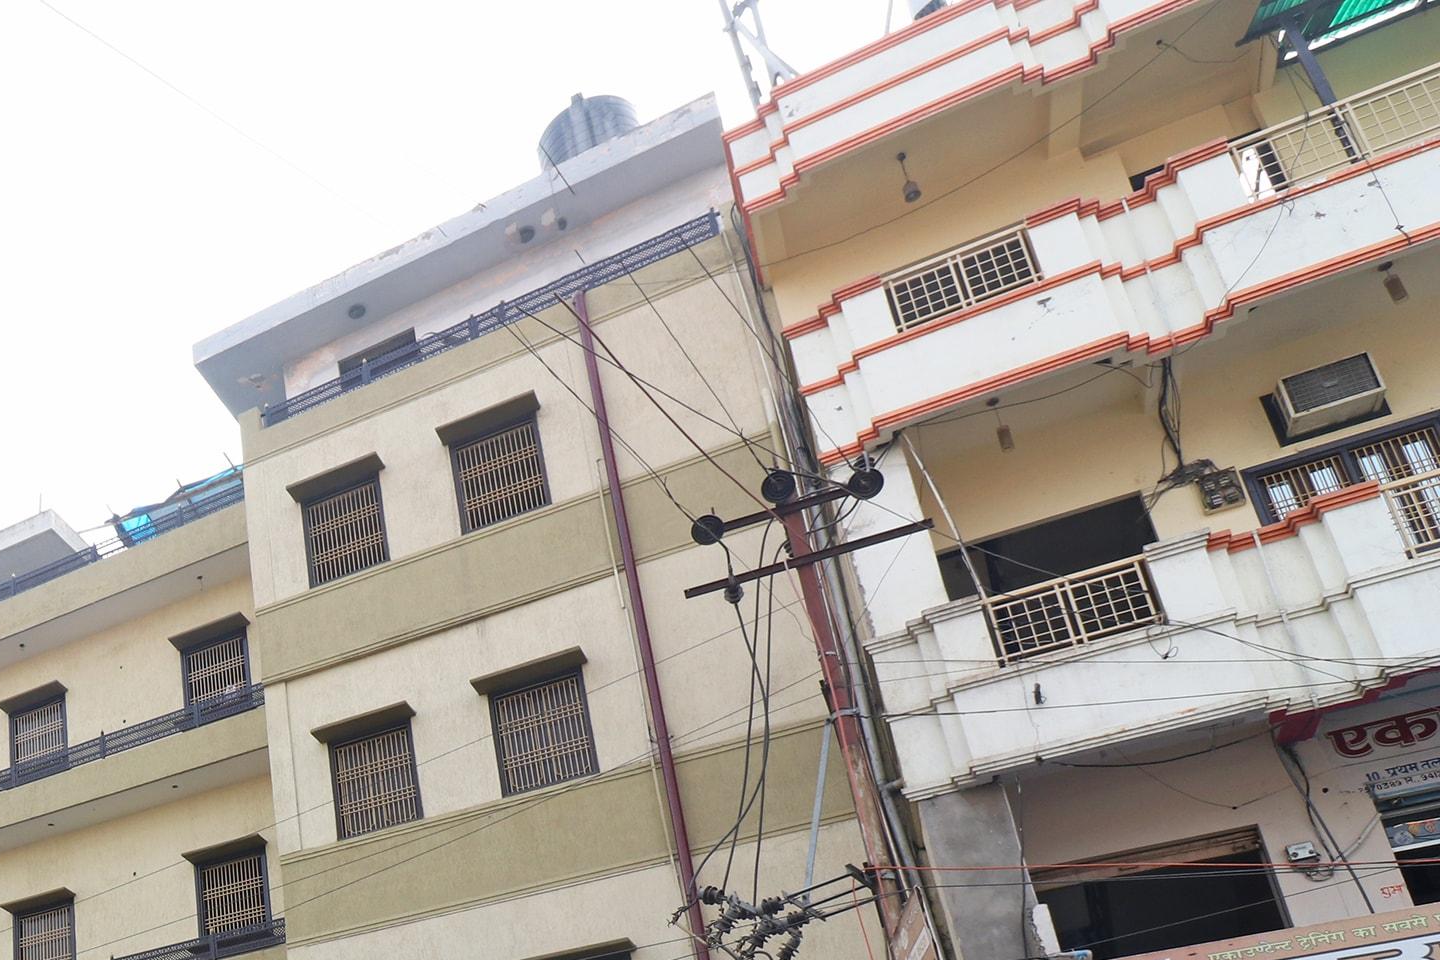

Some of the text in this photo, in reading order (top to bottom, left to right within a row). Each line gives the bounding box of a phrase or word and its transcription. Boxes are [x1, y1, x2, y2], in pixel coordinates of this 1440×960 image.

[1295, 930, 1345, 950] ट्रेनिंग
[1352, 925, 1377, 939] का
[1382, 915, 1428, 933] सबसे
